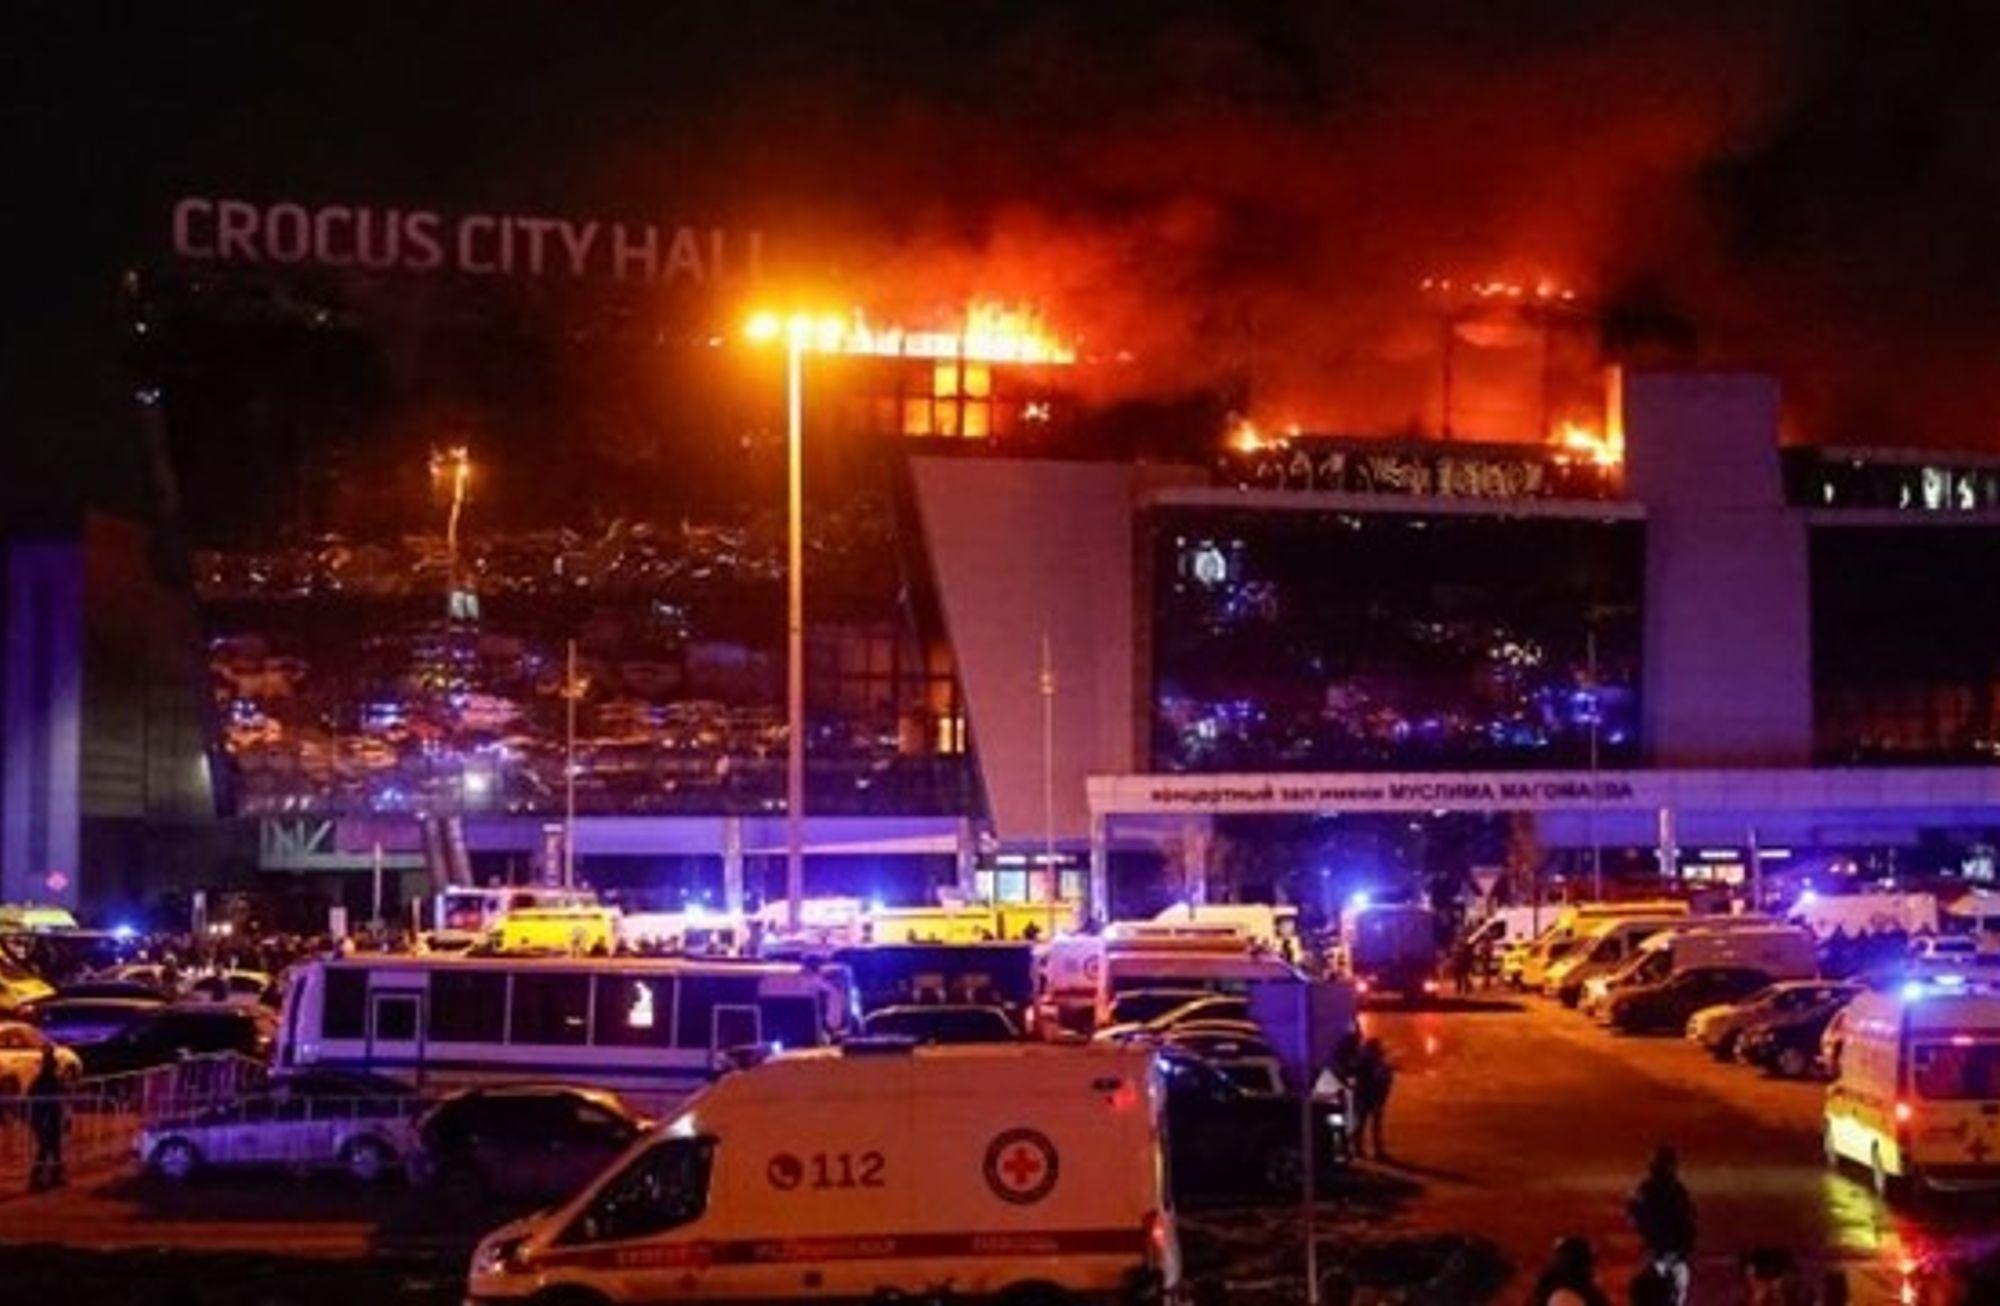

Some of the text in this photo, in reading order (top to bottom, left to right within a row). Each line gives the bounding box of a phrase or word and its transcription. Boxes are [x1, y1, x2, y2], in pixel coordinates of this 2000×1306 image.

[172, 196, 444, 270] CROCUS
[458, 213, 599, 276] CITY
[1388, 783, 1495, 800] МУСЛИМА
[811, 1150, 885, 1189] 112
